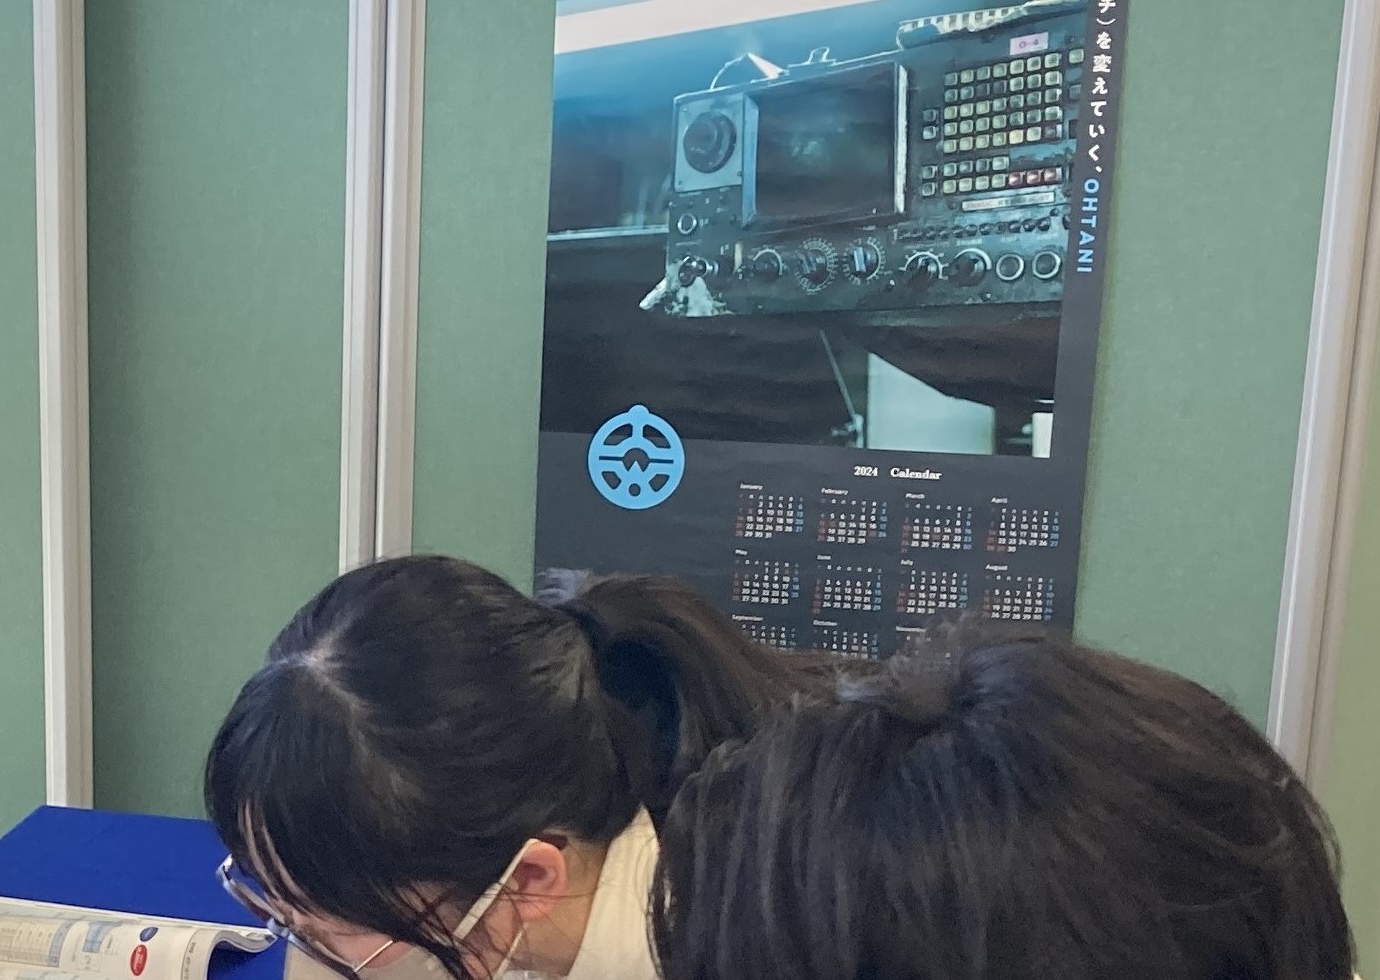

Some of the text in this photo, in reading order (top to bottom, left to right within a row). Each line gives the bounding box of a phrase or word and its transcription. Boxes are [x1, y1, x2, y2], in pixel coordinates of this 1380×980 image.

[1077, 178, 1100, 273] OHTANI
[854, 466, 942, 479] 2024 Calendar
